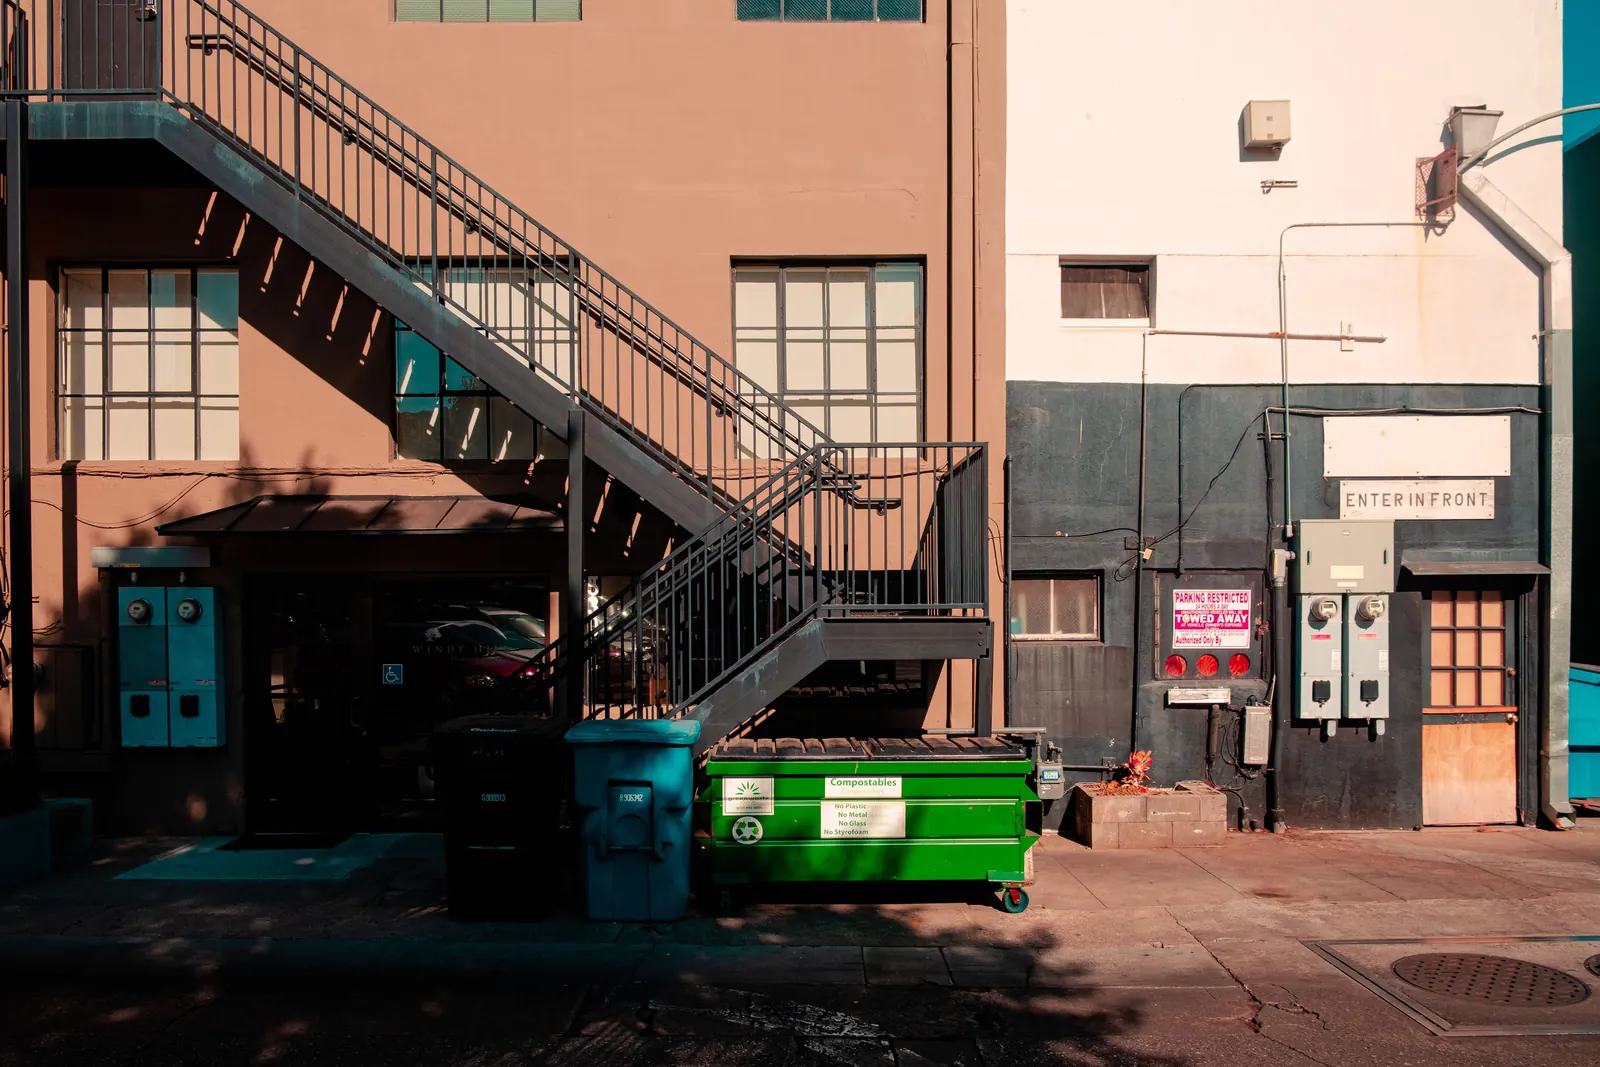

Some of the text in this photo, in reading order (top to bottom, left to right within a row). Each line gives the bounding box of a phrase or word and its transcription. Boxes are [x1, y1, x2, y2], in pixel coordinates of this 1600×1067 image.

[1346, 492, 1488, 507] ENTER IN FRONT
[1175, 592, 1248, 603] PARKING RESTRICTED
[1175, 615, 1248, 623] TOWED AWAY
[1175, 636, 1202, 644] Authorized
[1203, 636, 1214, 646] Only
[412, 644, 465, 654] WINDY
[830, 778, 897, 787] Compostables
